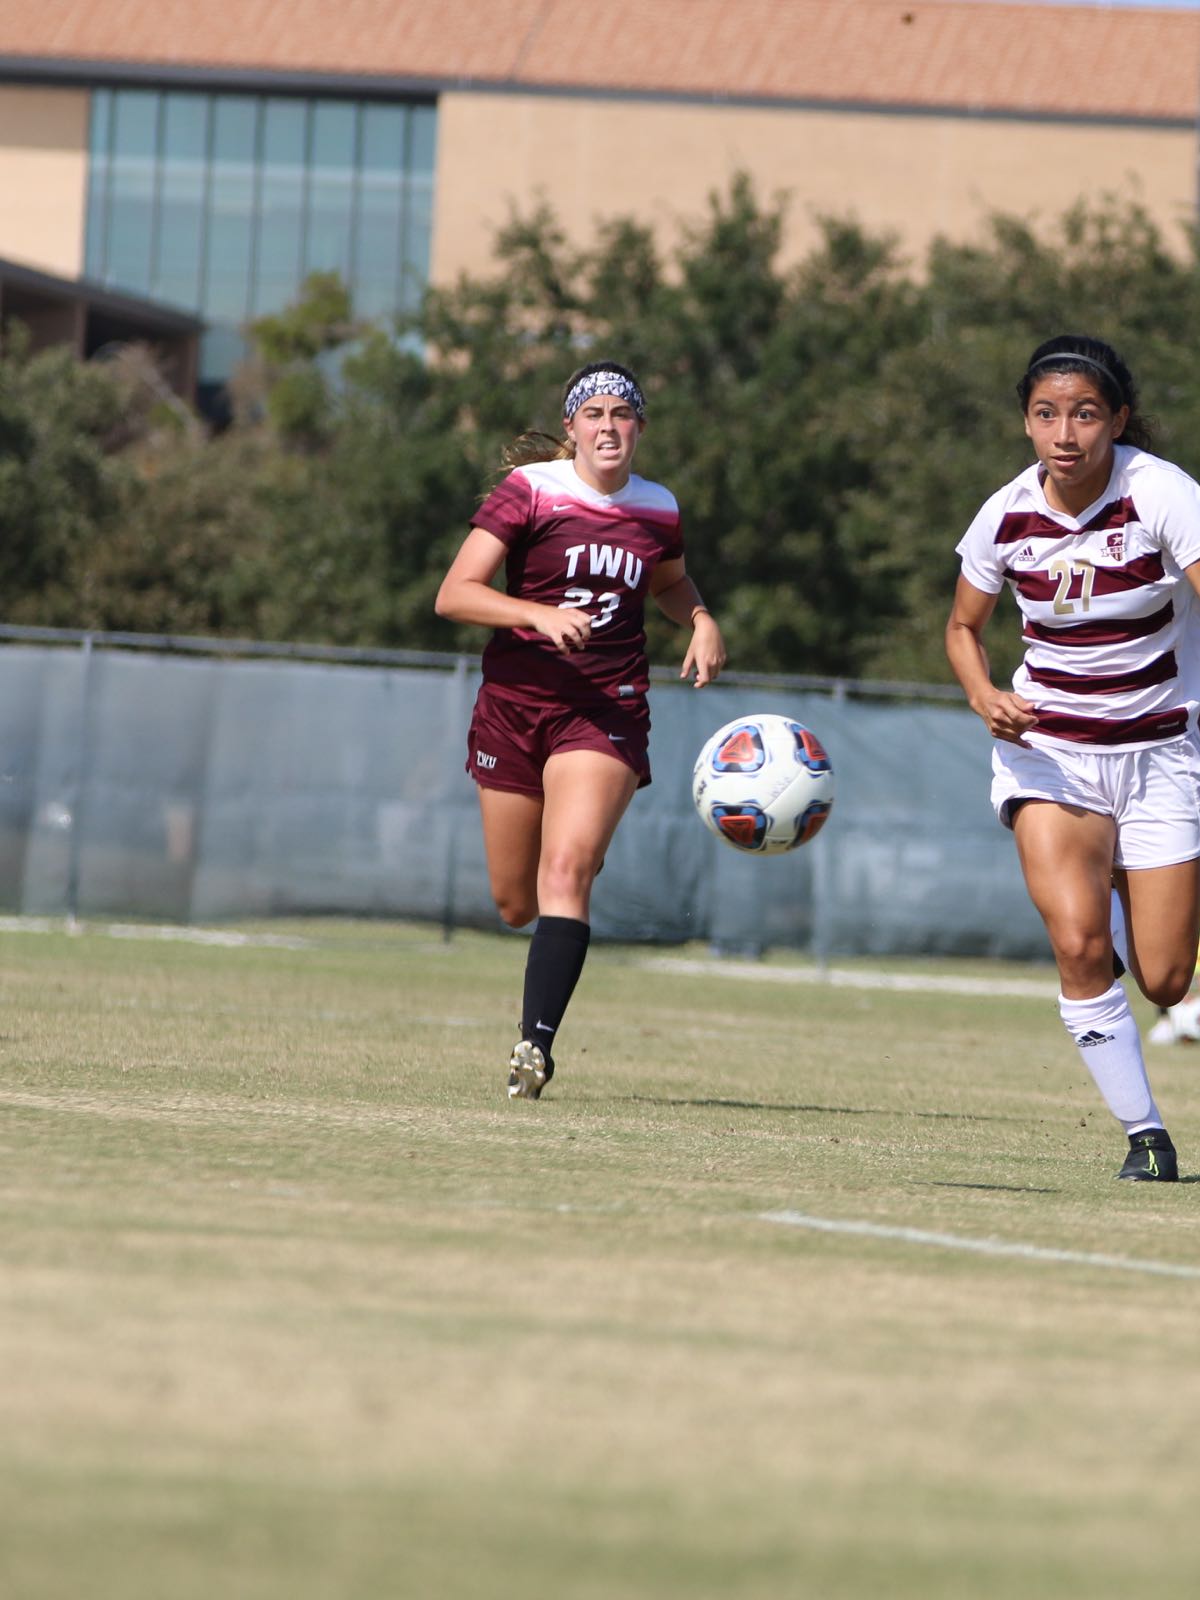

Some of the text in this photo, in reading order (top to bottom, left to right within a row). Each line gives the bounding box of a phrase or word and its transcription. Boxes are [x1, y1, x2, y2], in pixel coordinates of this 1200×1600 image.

[565, 543, 643, 590] TWU
[1048, 558, 1096, 615] 27
[558, 586, 621, 628] 23
[476, 750, 498, 769] TWU
